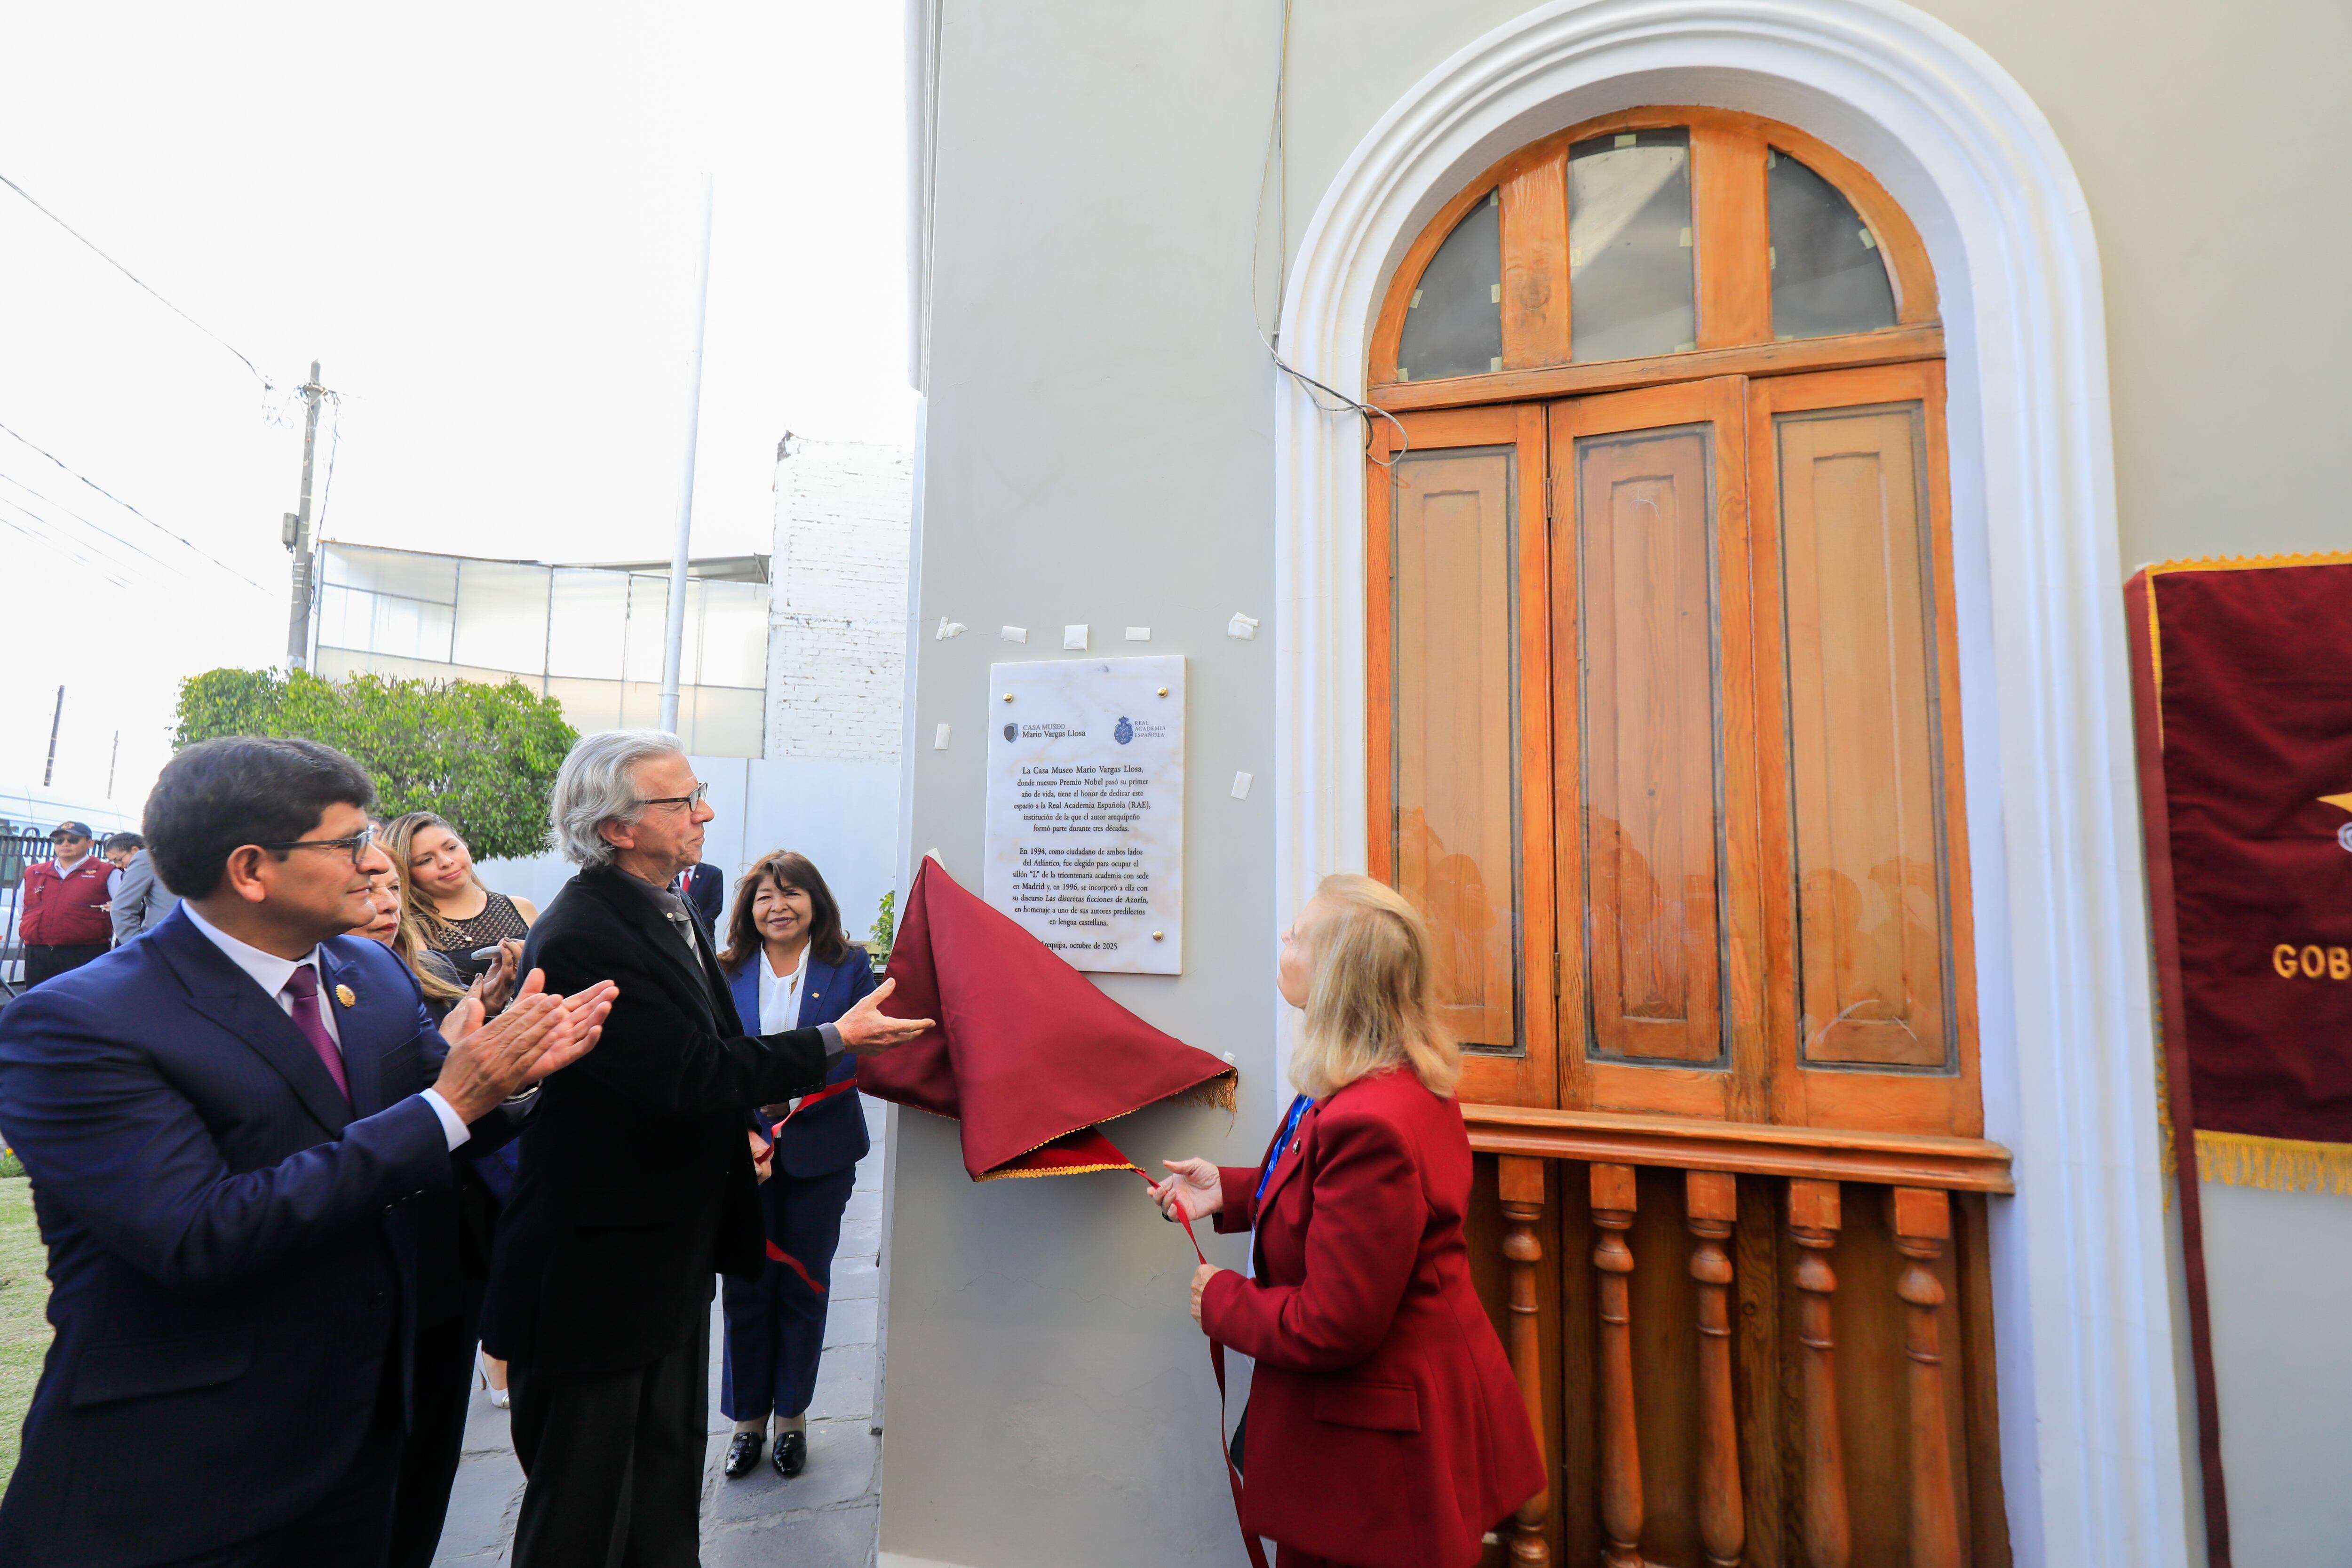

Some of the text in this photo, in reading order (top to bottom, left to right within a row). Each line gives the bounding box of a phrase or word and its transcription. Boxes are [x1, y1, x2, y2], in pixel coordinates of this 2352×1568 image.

[1099, 766, 1120, 775] Vargas
[1105, 779, 1118, 787] pasó
[1014, 803, 1033, 811] espacio
[1097, 801, 1125, 810] Española
[1128, 801, 1151, 810] (RAE),
[1108, 813, 1140, 822] arequipeño
[1074, 859, 1094, 869] elegido
[1089, 884, 1117, 893] incorporó
[1024, 905, 1050, 915] homenaje
[1113, 907, 1145, 916] predilectos
[1058, 917, 1076, 927] lengua
[1041, 941, 1067, 950] requipa,
[2273, 944, 2352, 979] GOB
